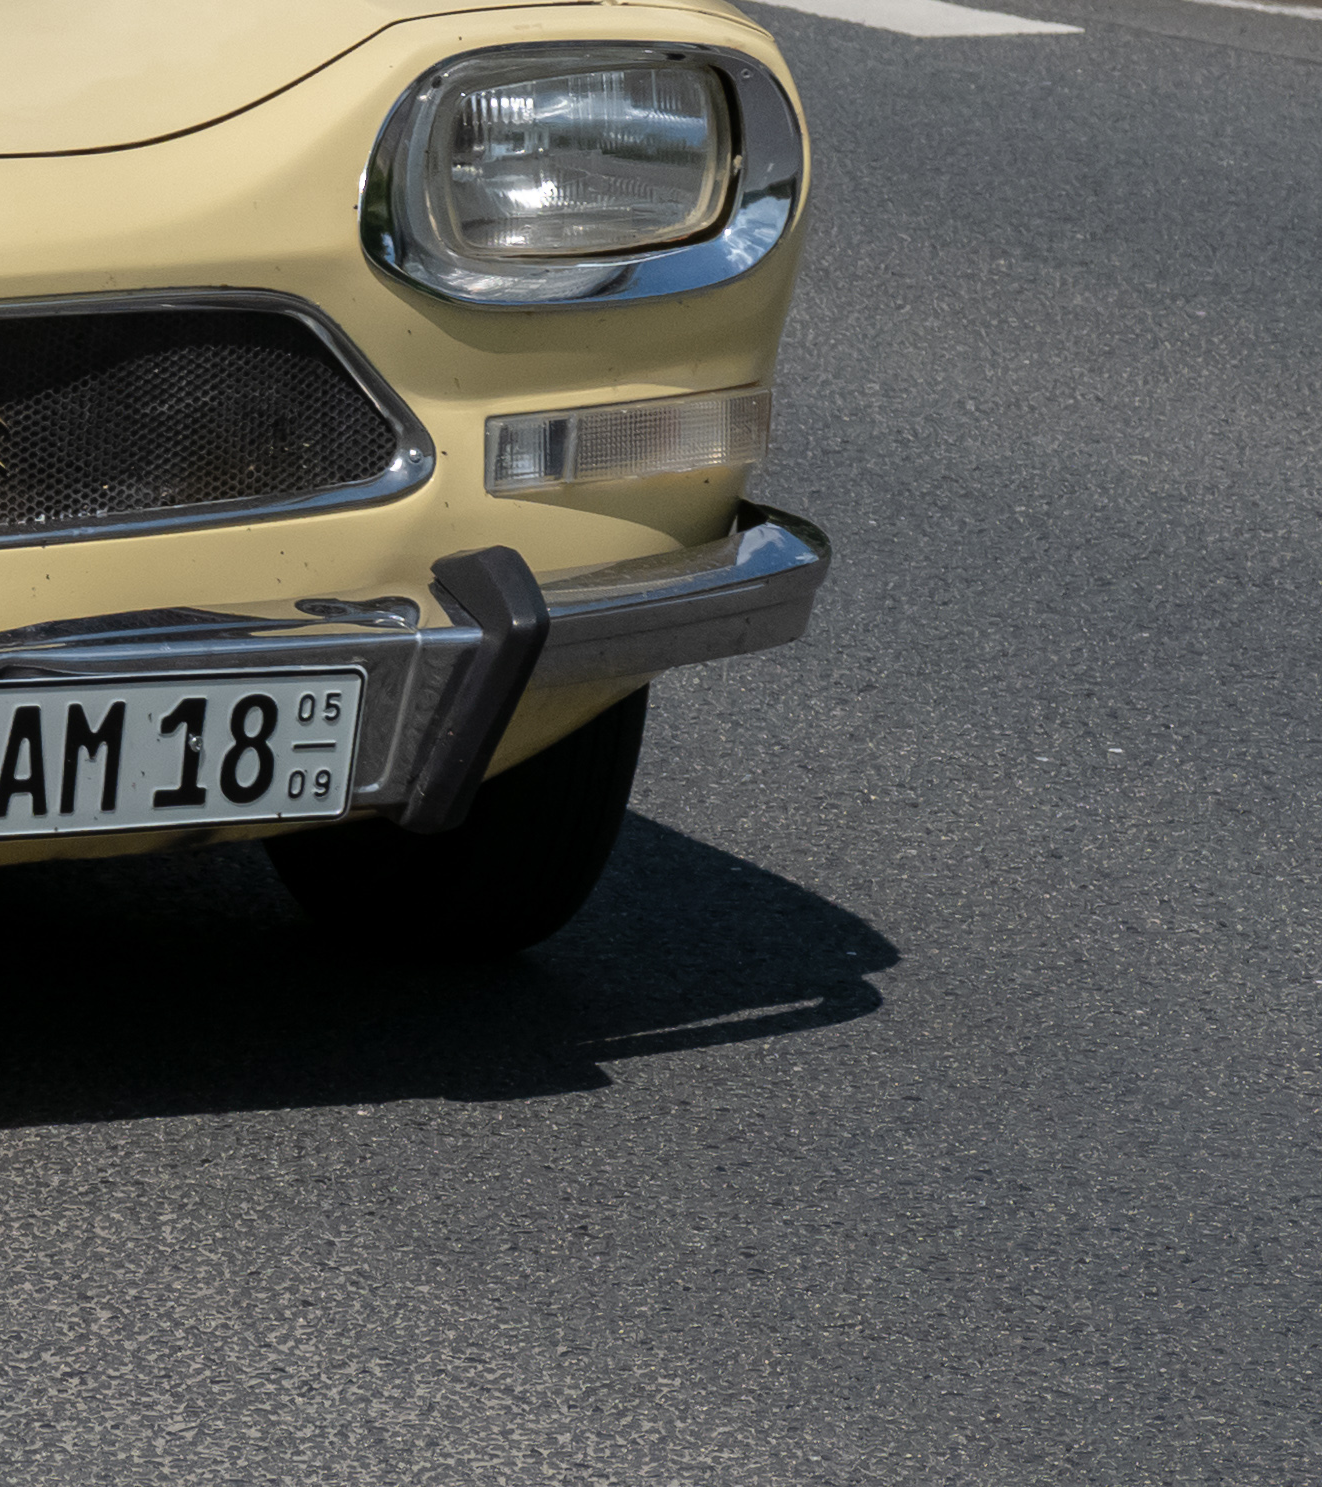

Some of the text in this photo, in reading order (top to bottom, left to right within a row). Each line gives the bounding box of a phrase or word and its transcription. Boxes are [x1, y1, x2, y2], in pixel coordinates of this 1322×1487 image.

[297, 692, 342, 723] 05
[153, 693, 278, 807] 18
[287, 769, 332, 799] 09
